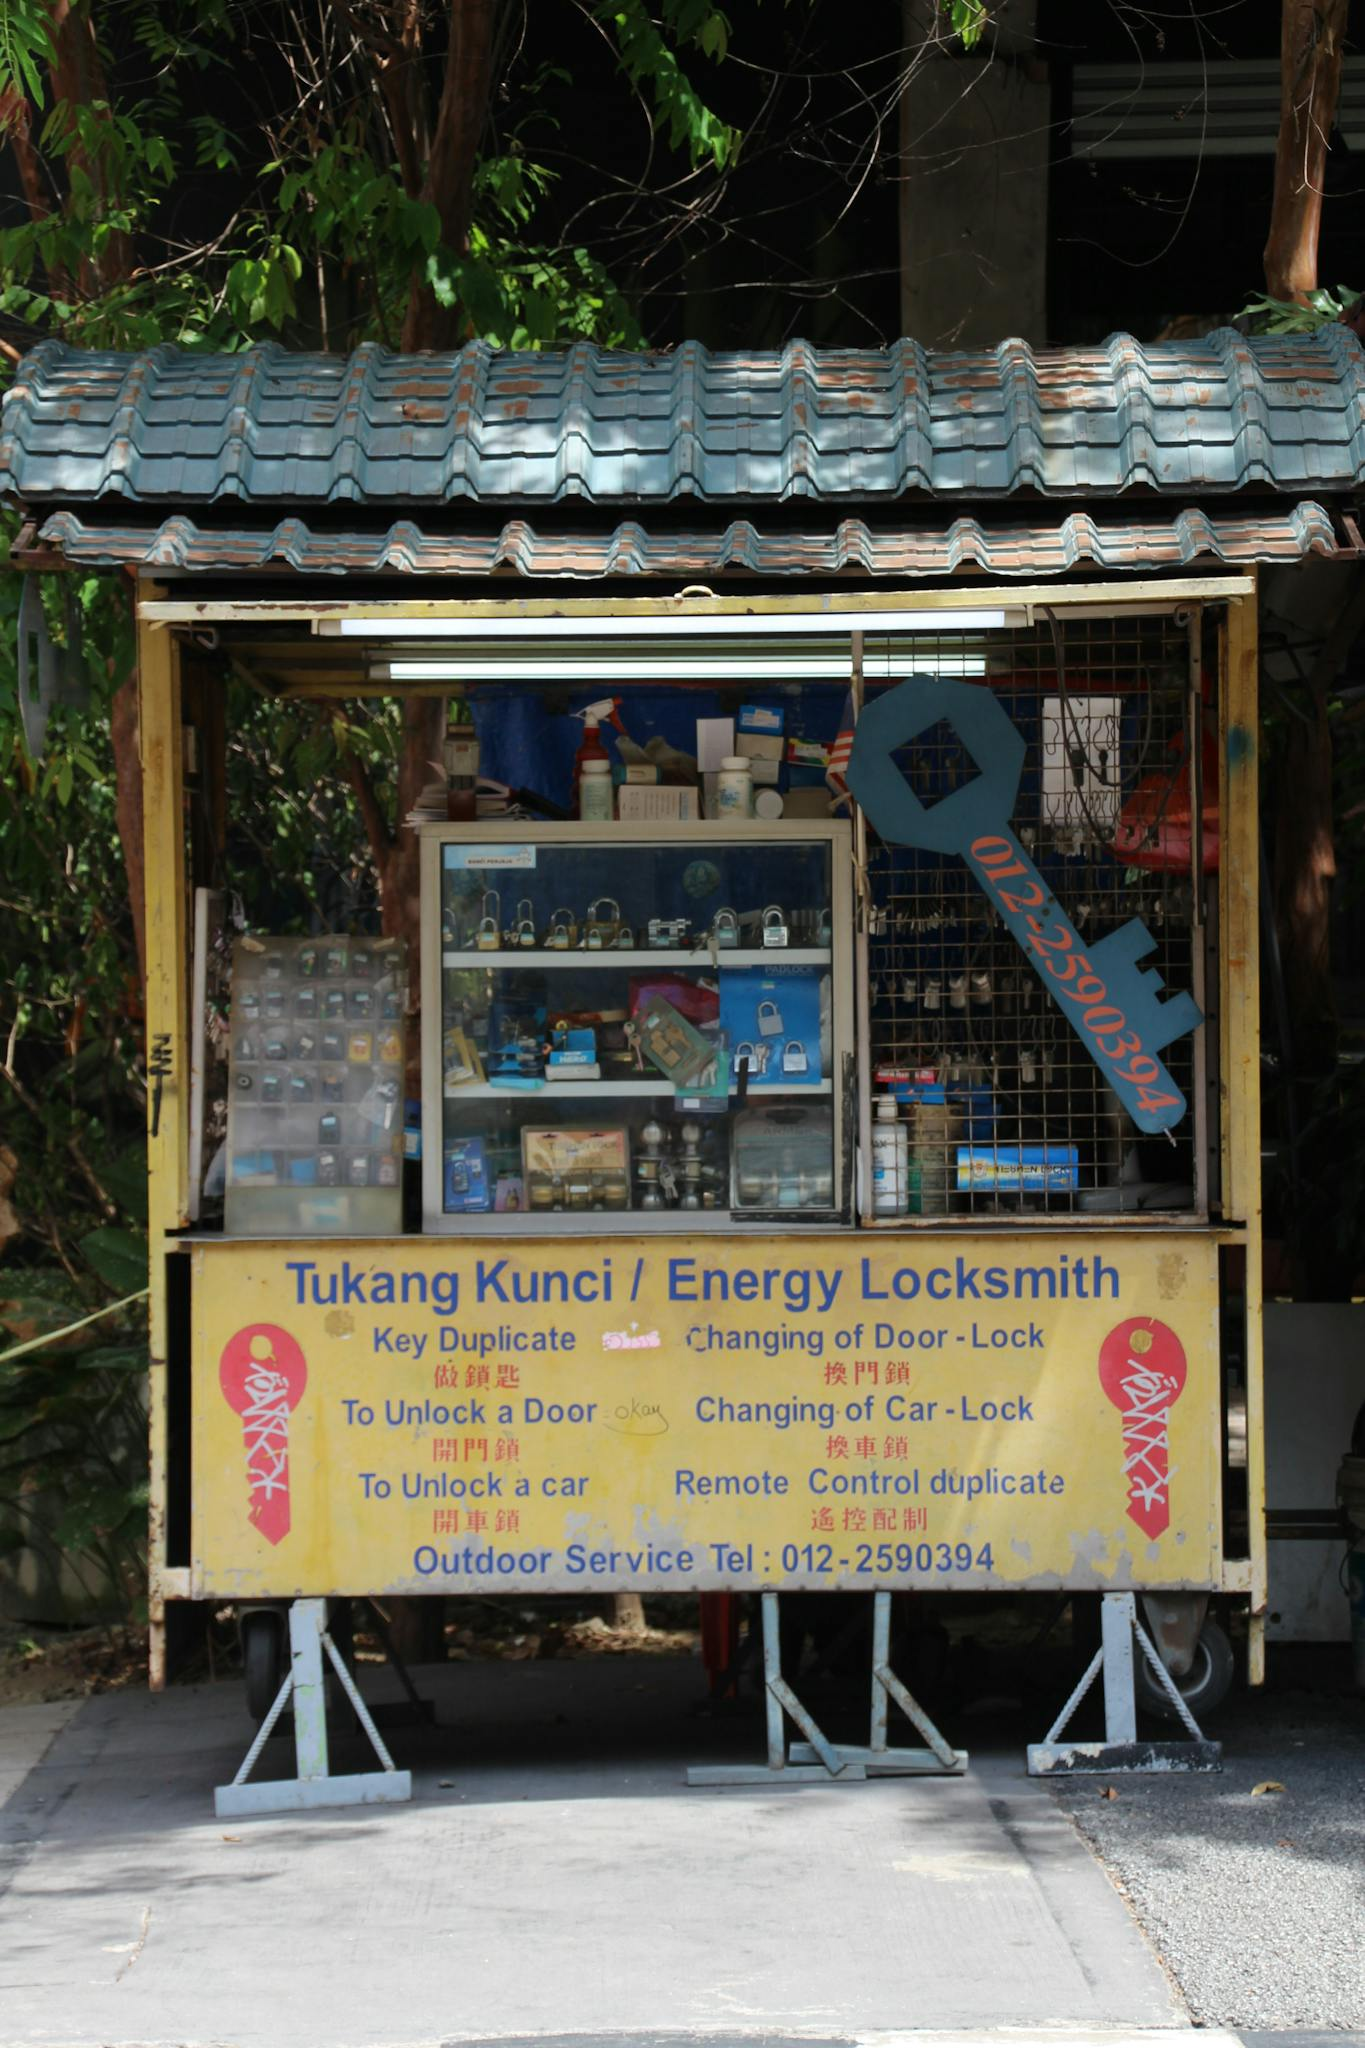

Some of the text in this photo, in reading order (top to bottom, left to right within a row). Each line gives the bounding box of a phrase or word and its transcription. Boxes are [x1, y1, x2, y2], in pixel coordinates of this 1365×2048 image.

[970, 836, 1180, 1114] 012-2590394
[286, 1262, 460, 1317] Tukang
[476, 1259, 613, 1304] Kunci
[668, 1258, 844, 1314] Energy
[861, 1255, 1121, 1303] Locksmith
[373, 1327, 577, 1359] Key Duplicate
[835, 1324, 863, 1350] of
[433, 1364, 520, 1391] 做鎖匙
[824, 1360, 912, 1386] 換門鎖
[343, 1398, 598, 1427] To Unlock a Door
[695, 1395, 835, 1430] Changing
[845, 1395, 874, 1422] of
[432, 1438, 521, 1464] 開門鎖
[826, 1436, 909, 1461] 換車鎖
[359, 1472, 589, 1500] To Unlock a car
[675, 1468, 1065, 1500] Remote Control duplicate
[432, 1509, 521, 1535] 開車鎖
[413, 1545, 554, 1577] Outdoor
[565, 1543, 695, 1576] Service
[781, 1543, 995, 1576] 012-2590394
